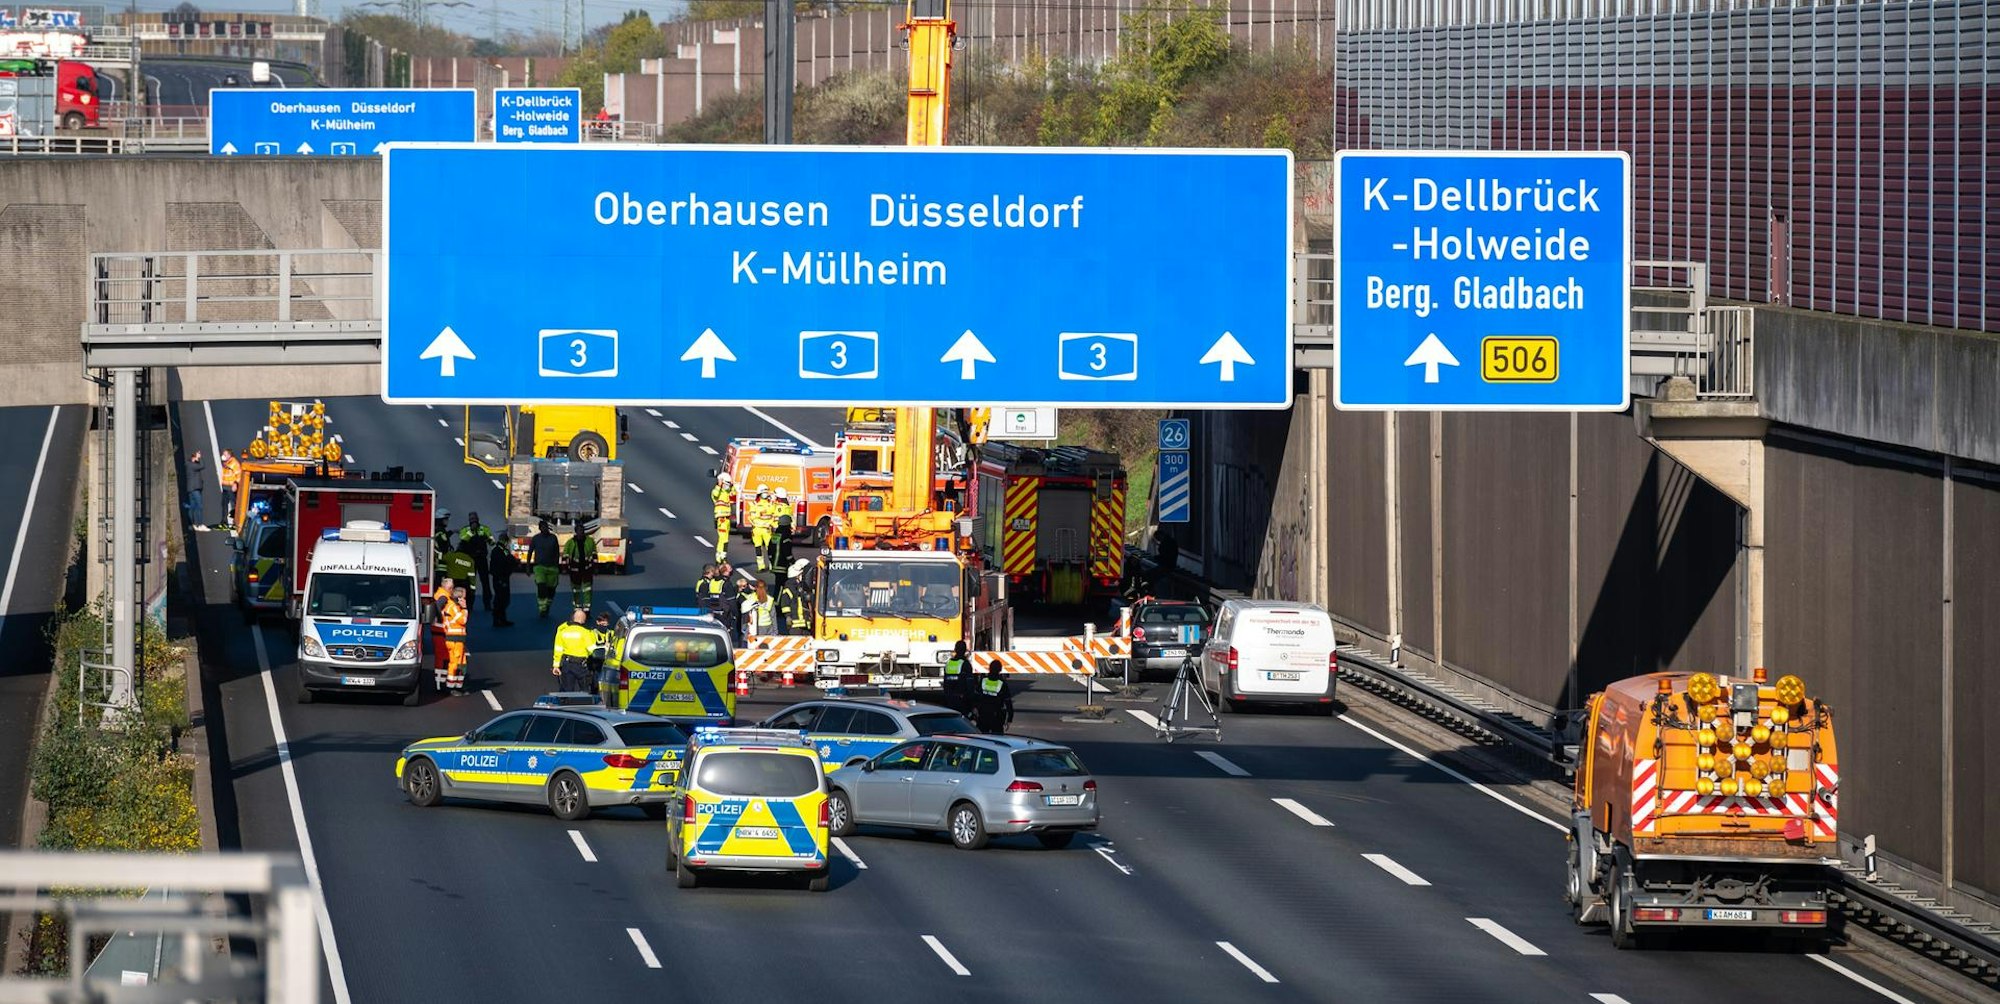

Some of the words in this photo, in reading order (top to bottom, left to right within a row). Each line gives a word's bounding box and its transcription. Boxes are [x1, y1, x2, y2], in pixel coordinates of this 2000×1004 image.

[501, 96, 572, 107] K-Dellbrück
[271, 102, 341, 114] Oberhausen
[351, 102, 416, 114] Düsseldorf
[510, 110, 570, 121] -Holweide
[311, 119, 376, 130] K-Mülheim
[502, 125, 525, 138] Berg.
[528, 125, 568, 136] Gladbach
[1364, 177, 1600, 212] K-Dellbrück
[594, 191, 828, 227] Oberhausen
[870, 193, 1084, 229] Düsseldorf
[1392, 226, 1590, 261] -Holweide
[732, 250, 946, 285] K-Mülheim
[1367, 275, 1438, 318] Berg.
[1454, 275, 1584, 310] Gladbach
[570, 340, 588, 368] 3
[830, 341, 847, 369] 3
[1089, 342, 1107, 371] 3
[1493, 346, 1547, 373] 506
[1164, 427, 1183, 442] 26
[1164, 454, 1184, 465] 300
[756, 475, 789, 483] NOTARZT
[320, 564, 407, 574] UNFALLAUFNAHME
[829, 562, 854, 570] KRAN
[857, 562, 864, 570] 2
[332, 629, 388, 639] POLIZEI
[1267, 627, 1305, 636] Thermondo
[631, 671, 666, 680] POLIZEI
[461, 755, 499, 767] POLIZEI
[697, 804, 742, 815] POLIZEI
